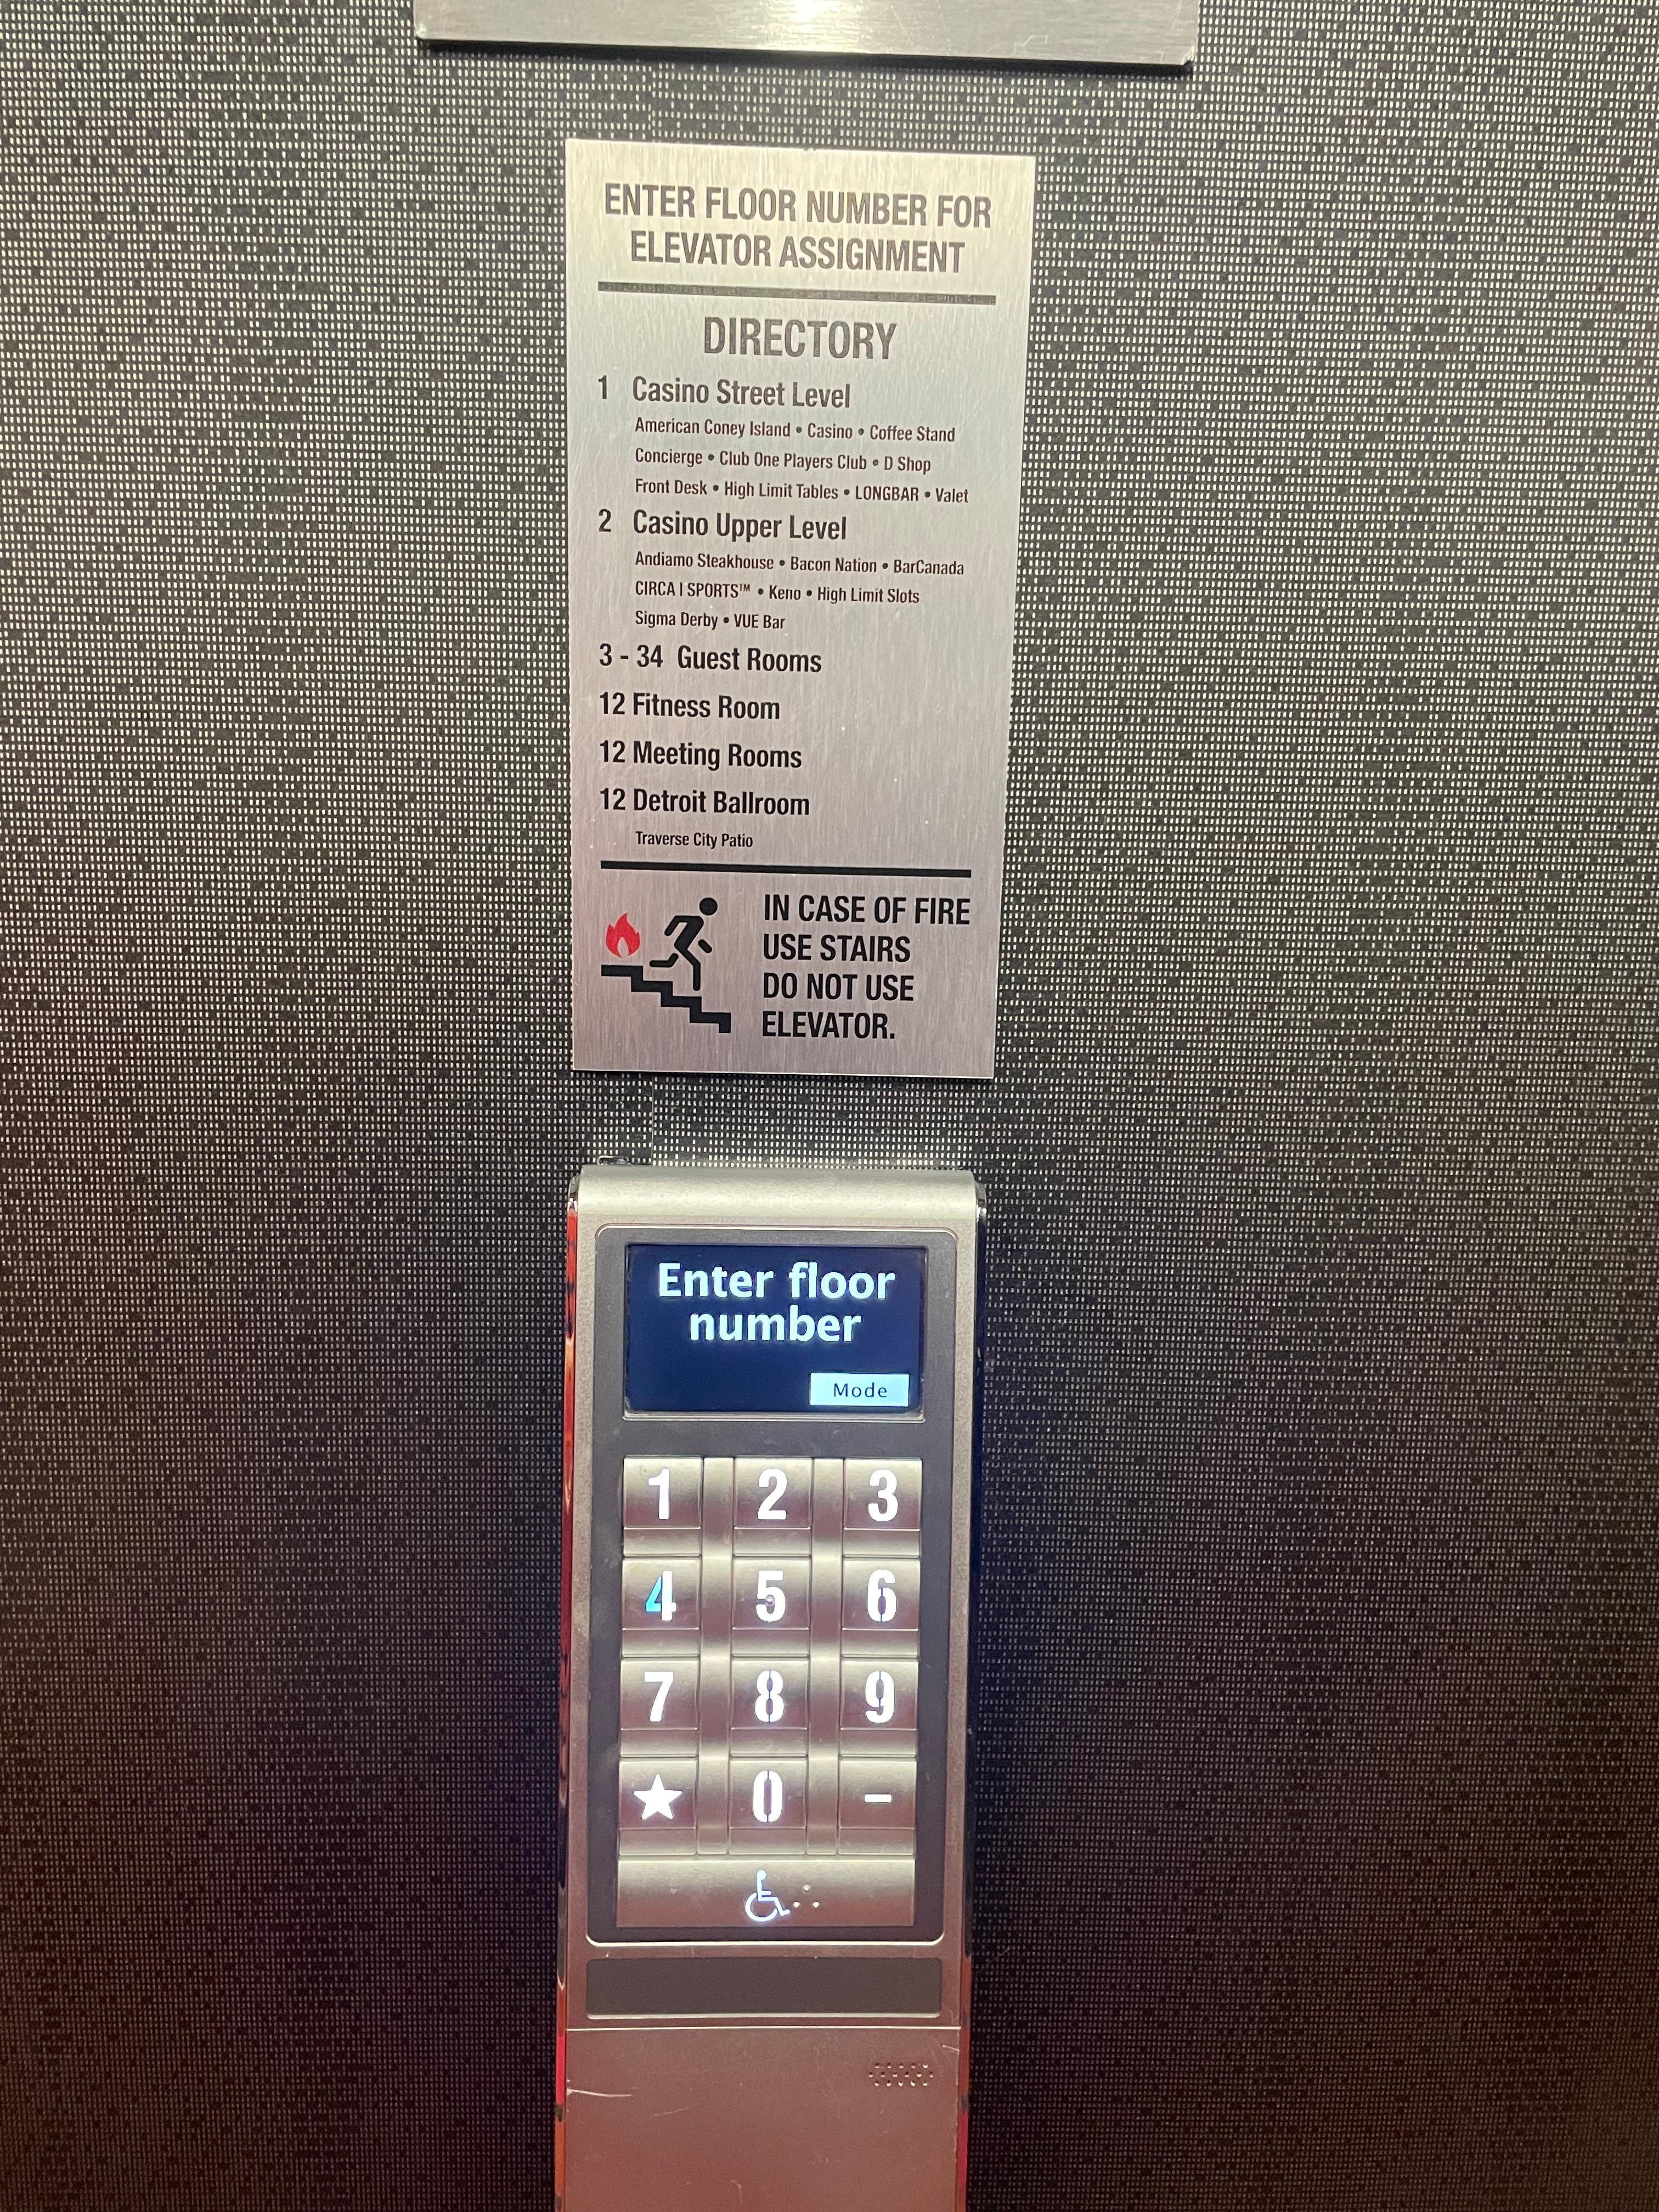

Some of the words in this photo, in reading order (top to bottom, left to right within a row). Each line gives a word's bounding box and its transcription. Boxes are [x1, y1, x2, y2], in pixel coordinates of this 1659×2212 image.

[605, 183, 695, 218] ENTER
[705, 187, 796, 222] FLOOR
[806, 190, 927, 226] NUMBER
[938, 195, 991, 228] FOR
[630, 230, 771, 266] ELEVATOR
[779, 236, 965, 273] ASSIGNMENT
[704, 317, 897, 359] DIRECTORY
[597, 375, 608, 400] 1
[633, 377, 709, 403] Casino
[716, 379, 785, 405] Street
[792, 381, 851, 408] Level
[635, 417, 701, 435] American
[704, 420, 746, 439] Coney
[750, 420, 791, 437] Island
[807, 423, 853, 439] Casino
[869, 425, 912, 441] Coffee
[916, 426, 955, 442] Stand
[635, 448, 703, 468] Concierge
[720, 451, 750, 466] Club
[754, 452, 780, 467] One
[783, 453, 833, 471] Players
[837, 453, 867, 470] Club
[884, 456, 893, 470] D
[897, 457, 931, 474] Shop
[635, 479, 670, 495] Front
[674, 480, 708, 495] Desk
[724, 482, 754, 500] High
[758, 483, 792, 498] Limit
[795, 484, 838, 499] Tables
[855, 486, 919, 501] LONGBAR
[935, 487, 968, 503] Valet
[598, 508, 612, 533] 2
[633, 510, 708, 536] Casino
[716, 512, 782, 542] Upper
[789, 515, 848, 540] Level
[635, 551, 693, 568] Andiamo
[697, 554, 774, 571] Steakhouse
[790, 556, 831, 572] Bacon
[834, 557, 877, 573] Nation
[893, 560, 964, 575] BarCanada
[635, 581, 675, 596] CIRCA
[769, 586, 801, 601] Keno
[817, 587, 847, 604] High
[850, 588, 883, 602] Limit
[887, 589, 920, 604] Slots
[635, 611, 676, 629] Sigma
[680, 612, 718, 630] Derby
[733, 614, 759, 628] VUE
[763, 614, 785, 629] Bar
[599, 643, 612, 667] 3
[636, 644, 663, 669] 34
[678, 645, 740, 671] Guest
[747, 648, 822, 673] Rooms
[599, 692, 625, 715] 12
[632, 693, 711, 718] Fitness
[718, 695, 780, 720] Room
[599, 740, 625, 764] 12
[632, 741, 721, 771] Meeting
[728, 743, 802, 768] Rooms
[600, 788, 625, 811] 12
[633, 789, 707, 814] Detroit
[713, 791, 810, 816] Ballroom
[635, 831, 690, 848] Traverse
[693, 832, 718, 850] City
[721, 833, 753, 848] Patio
[764, 894, 788, 921] IN
[798, 895, 866, 923] CASE
[874, 897, 906, 924] OF
[915, 898, 970, 925] FIRE
[763, 934, 812, 960] USE
[820, 935, 910, 963] STAIRS
[763, 973, 798, 1000] DO
[806, 974, 858, 1000] NOT
[865, 975, 914, 1001] USE
[763, 1012, 895, 1040] ELEVATOR.
[658, 1261, 775, 1299] Enter
[789, 1261, 895, 1300] floor
[689, 1305, 862, 1342] number
[833, 1381, 888, 1398] Mode
[648, 1468, 670, 1520] 1
[757, 1468, 787, 1520] 2
[868, 1469, 899, 1522] 3
[645, 1570, 676, 1622] 4
[755, 1570, 786, 1622] 5
[867, 1569, 898, 1622] 6
[644, 1672, 674, 1723] 7
[754, 1669, 785, 1723] 8
[865, 1671, 896, 1723] 9
[752, 1769, 783, 1823] 0
